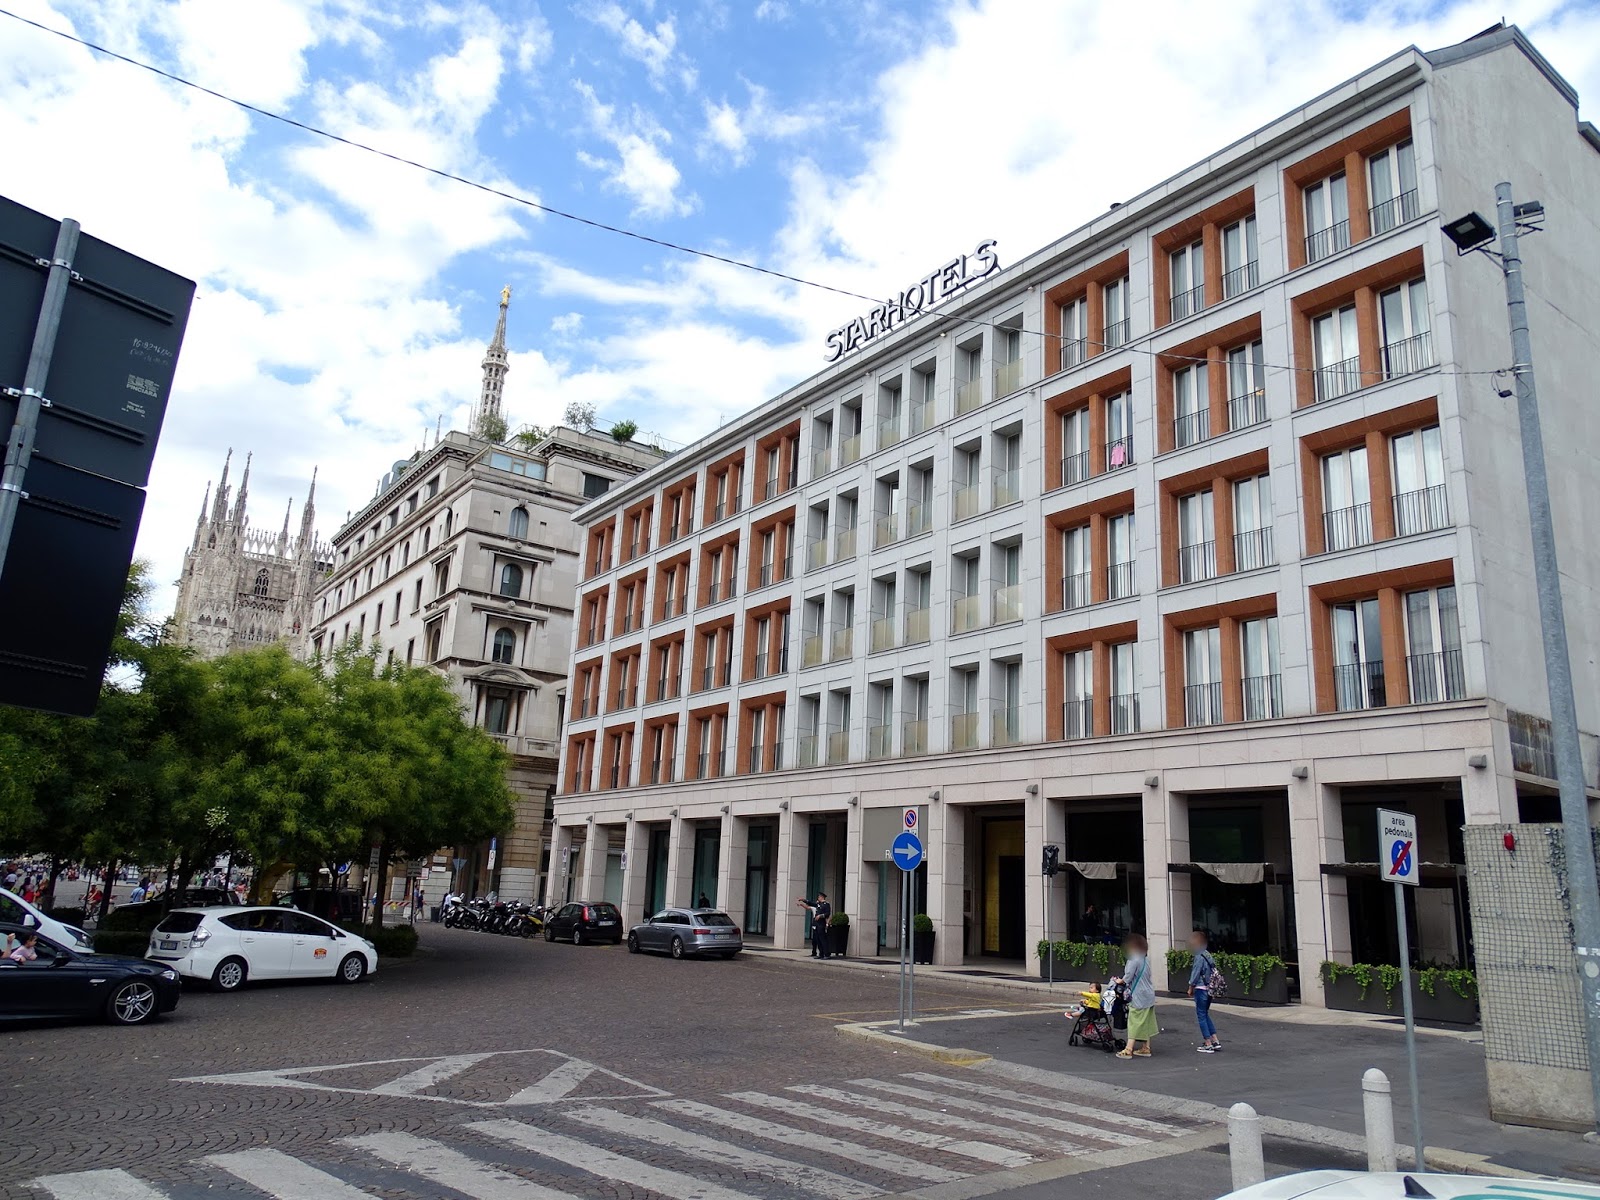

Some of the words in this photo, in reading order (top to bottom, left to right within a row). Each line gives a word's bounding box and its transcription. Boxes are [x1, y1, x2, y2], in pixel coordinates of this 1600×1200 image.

[823, 238, 998, 362] STARHOTELS
[126, 383, 158, 398] PINCIARA
[1391, 817, 1405, 826] area
[1384, 827, 1413, 838] pedonale
